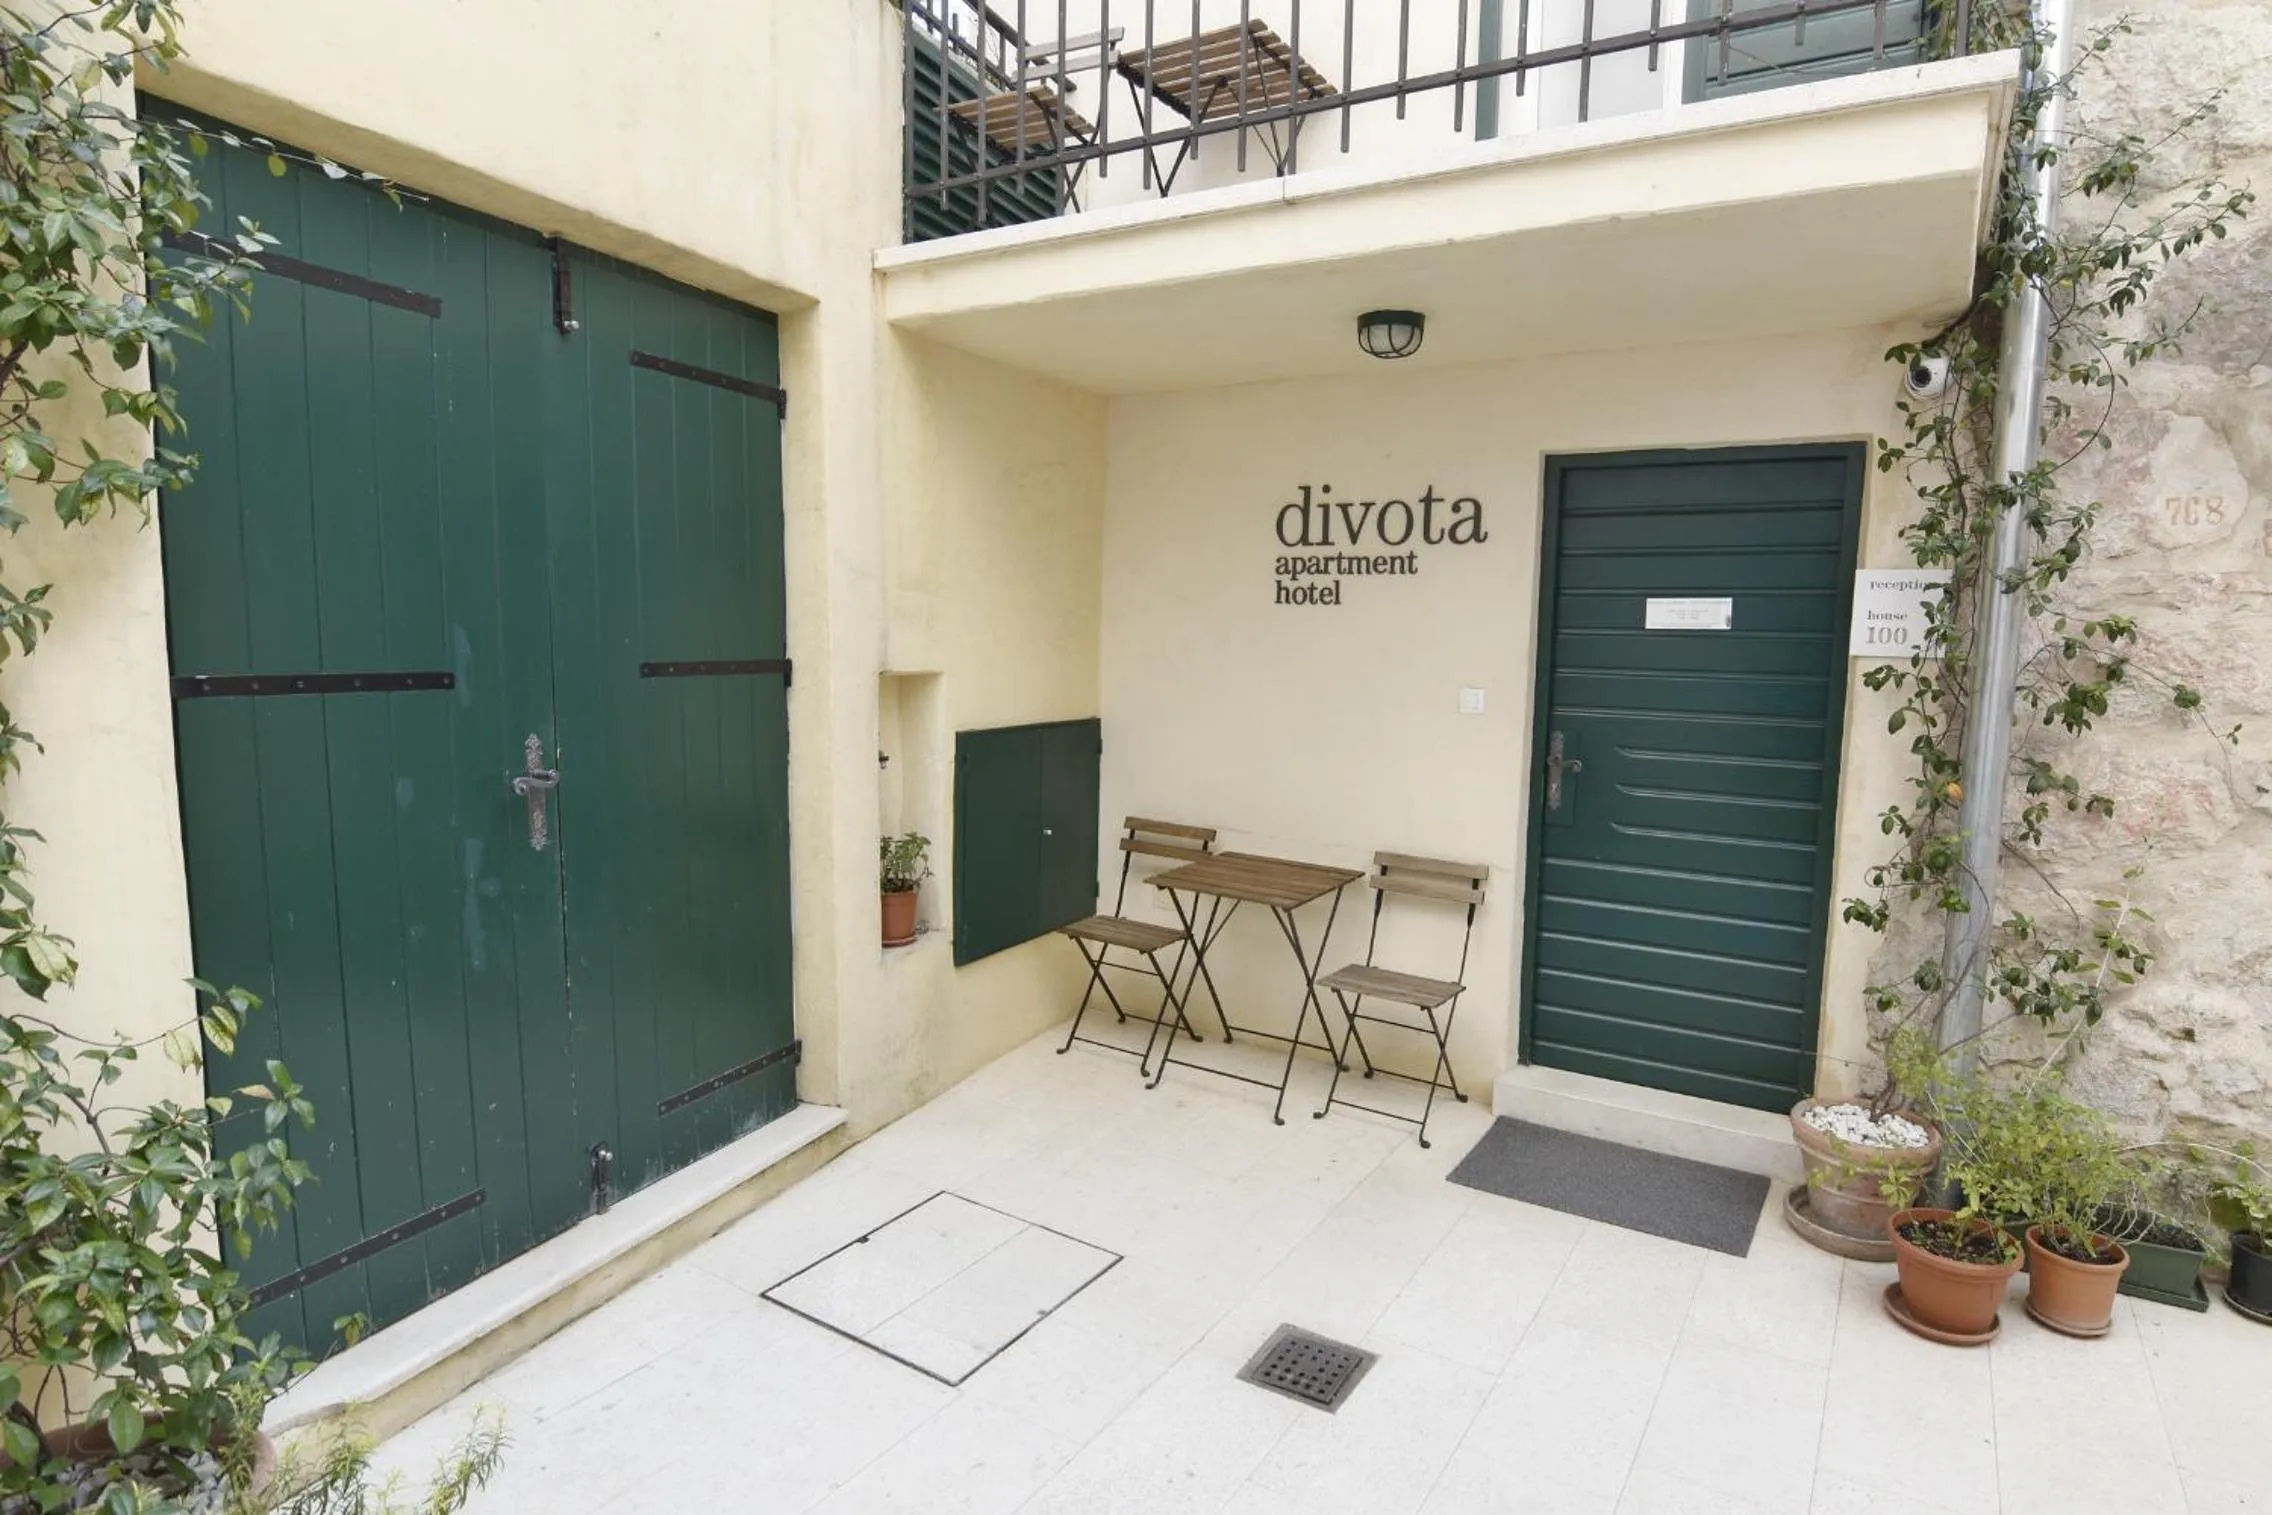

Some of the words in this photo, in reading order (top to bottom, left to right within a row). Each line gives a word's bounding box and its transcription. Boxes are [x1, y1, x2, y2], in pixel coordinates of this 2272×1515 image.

[1276, 484, 1488, 547] divota
[1275, 550, 1418, 581] apartment
[1275, 580, 1341, 605] hotel
[1870, 579, 1929, 591] receptio
[1866, 609, 1908, 620] house
[1866, 626, 1907, 645] 100
